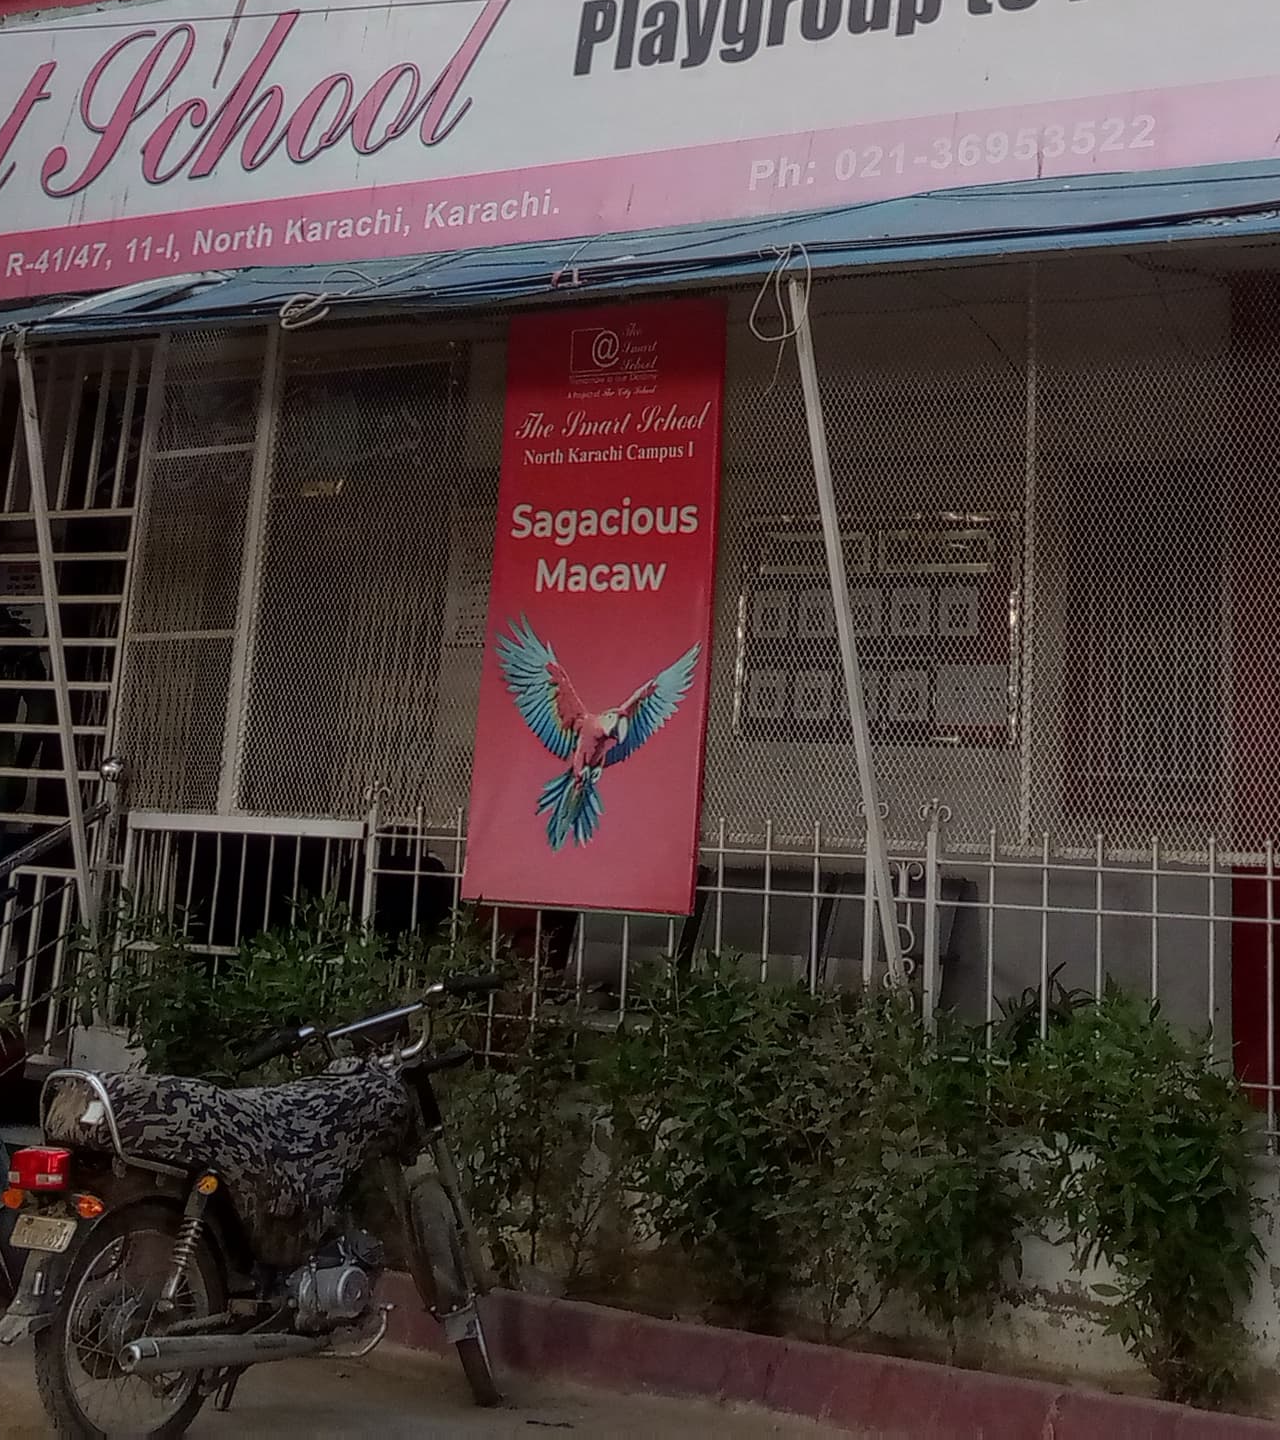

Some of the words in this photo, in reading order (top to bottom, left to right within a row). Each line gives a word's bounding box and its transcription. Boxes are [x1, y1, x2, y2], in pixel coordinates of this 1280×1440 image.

[748, 155, 815, 192] Ph:
[833, 114, 1156, 182] 021-36953522
[6, 242, 113, 277] R-41/47,
[191, 222, 273, 256] North
[283, 207, 412, 246] Karachi,
[423, 188, 561, 230] Karachi.
[514, 411, 555, 440] The
[561, 408, 632, 438] Smart
[636, 400, 712, 433] School
[523, 448, 564, 466] North
[567, 444, 624, 464] Karachi
[626, 443, 684, 464] Campus
[511, 497, 699, 546] Sagacious
[534, 558, 667, 593] Macaw
